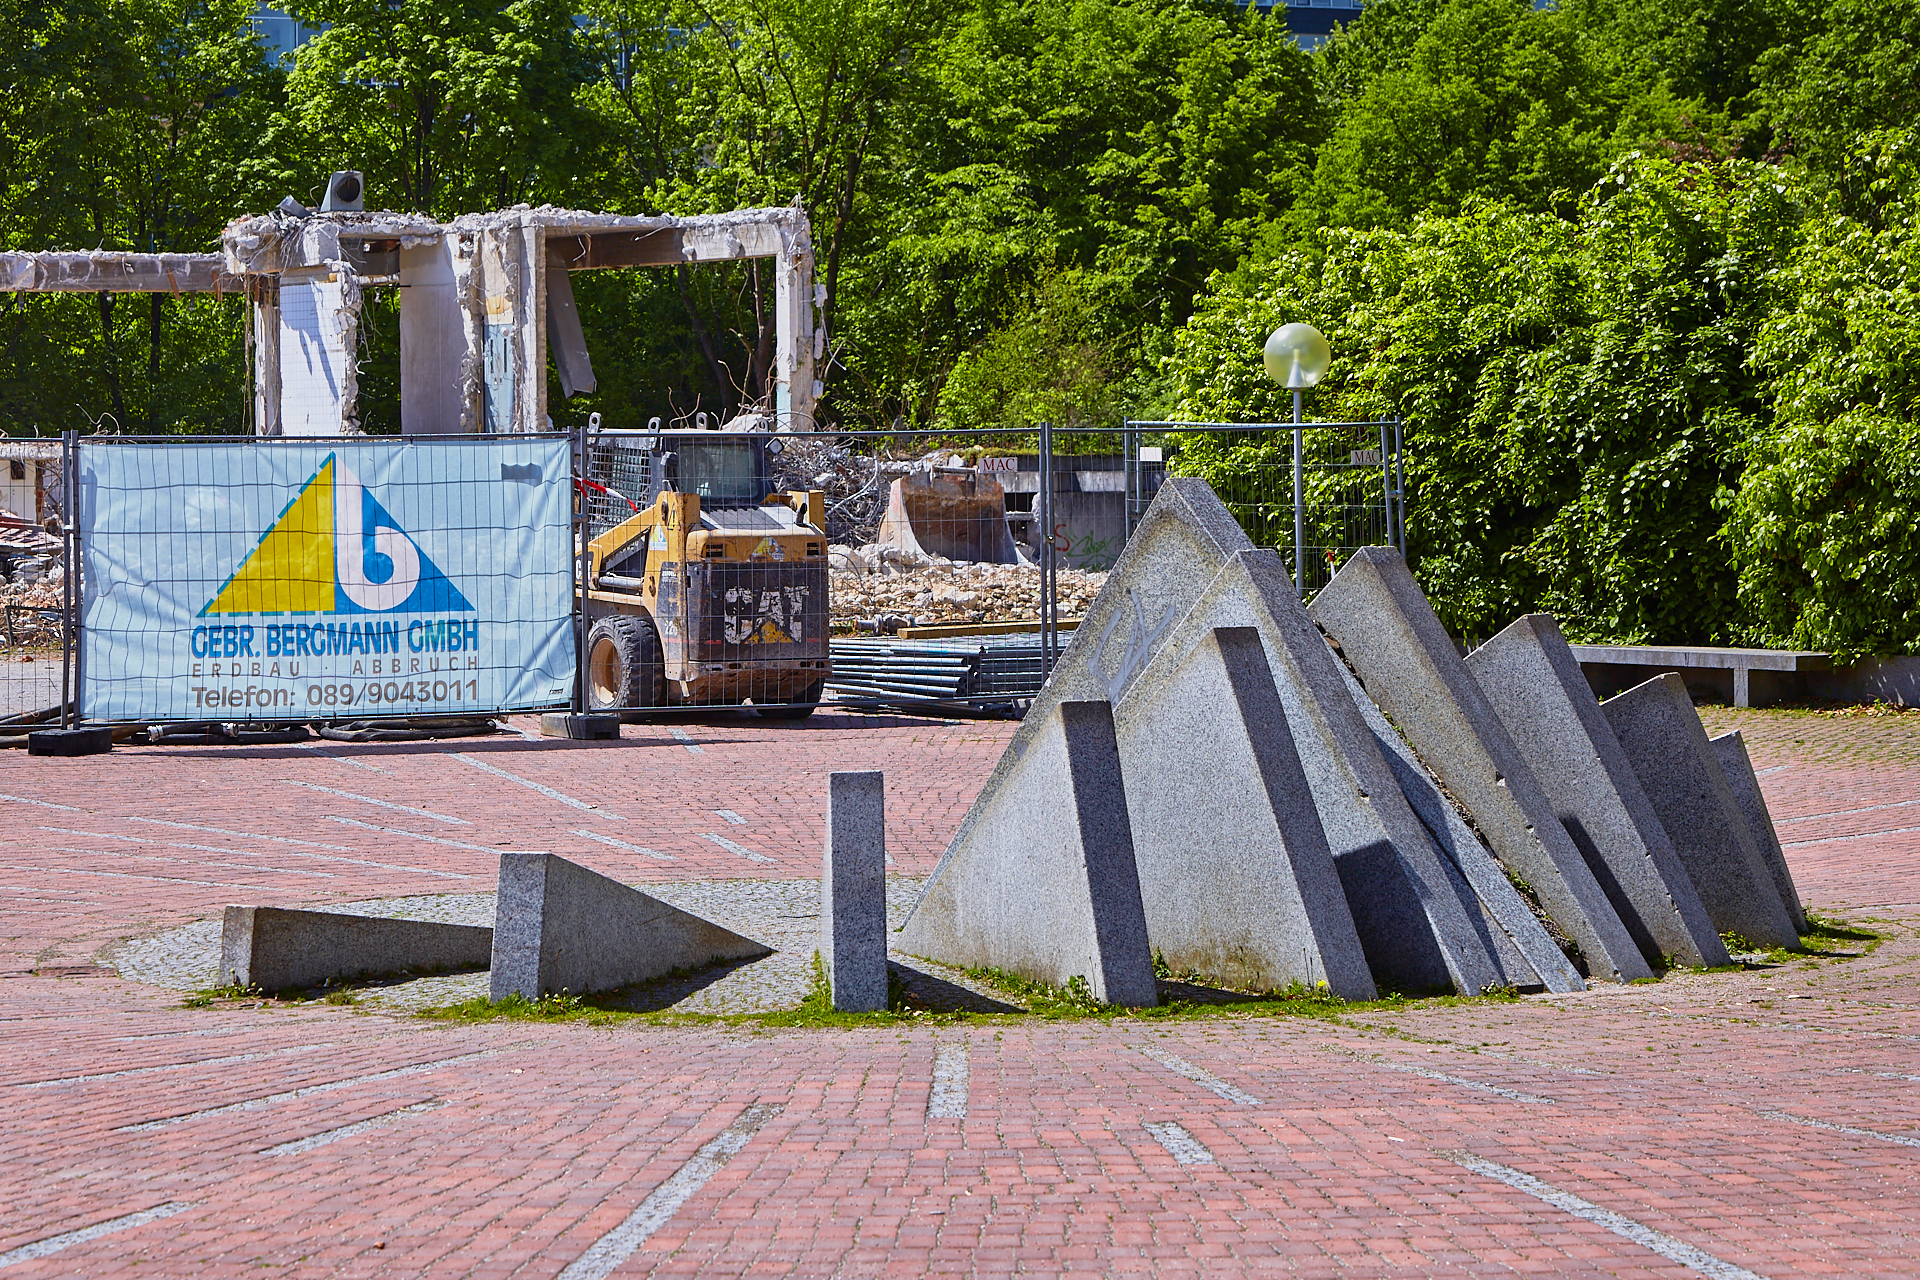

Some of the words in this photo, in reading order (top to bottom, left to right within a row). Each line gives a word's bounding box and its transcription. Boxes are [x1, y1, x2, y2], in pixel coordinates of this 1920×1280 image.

[983, 458, 1015, 471] MAC
[1355, 451, 1378, 463] MAC
[724, 586, 809, 644] CAT
[191, 624, 260, 659] GEBR.
[266, 621, 399, 657] BERGMANN
[408, 619, 478, 653] GMBH
[192, 661, 299, 678] ERDBAU
[352, 656, 477, 674] ABBRUCH
[191, 685, 296, 708] Telefon:
[307, 680, 477, 706] 089/9043011
